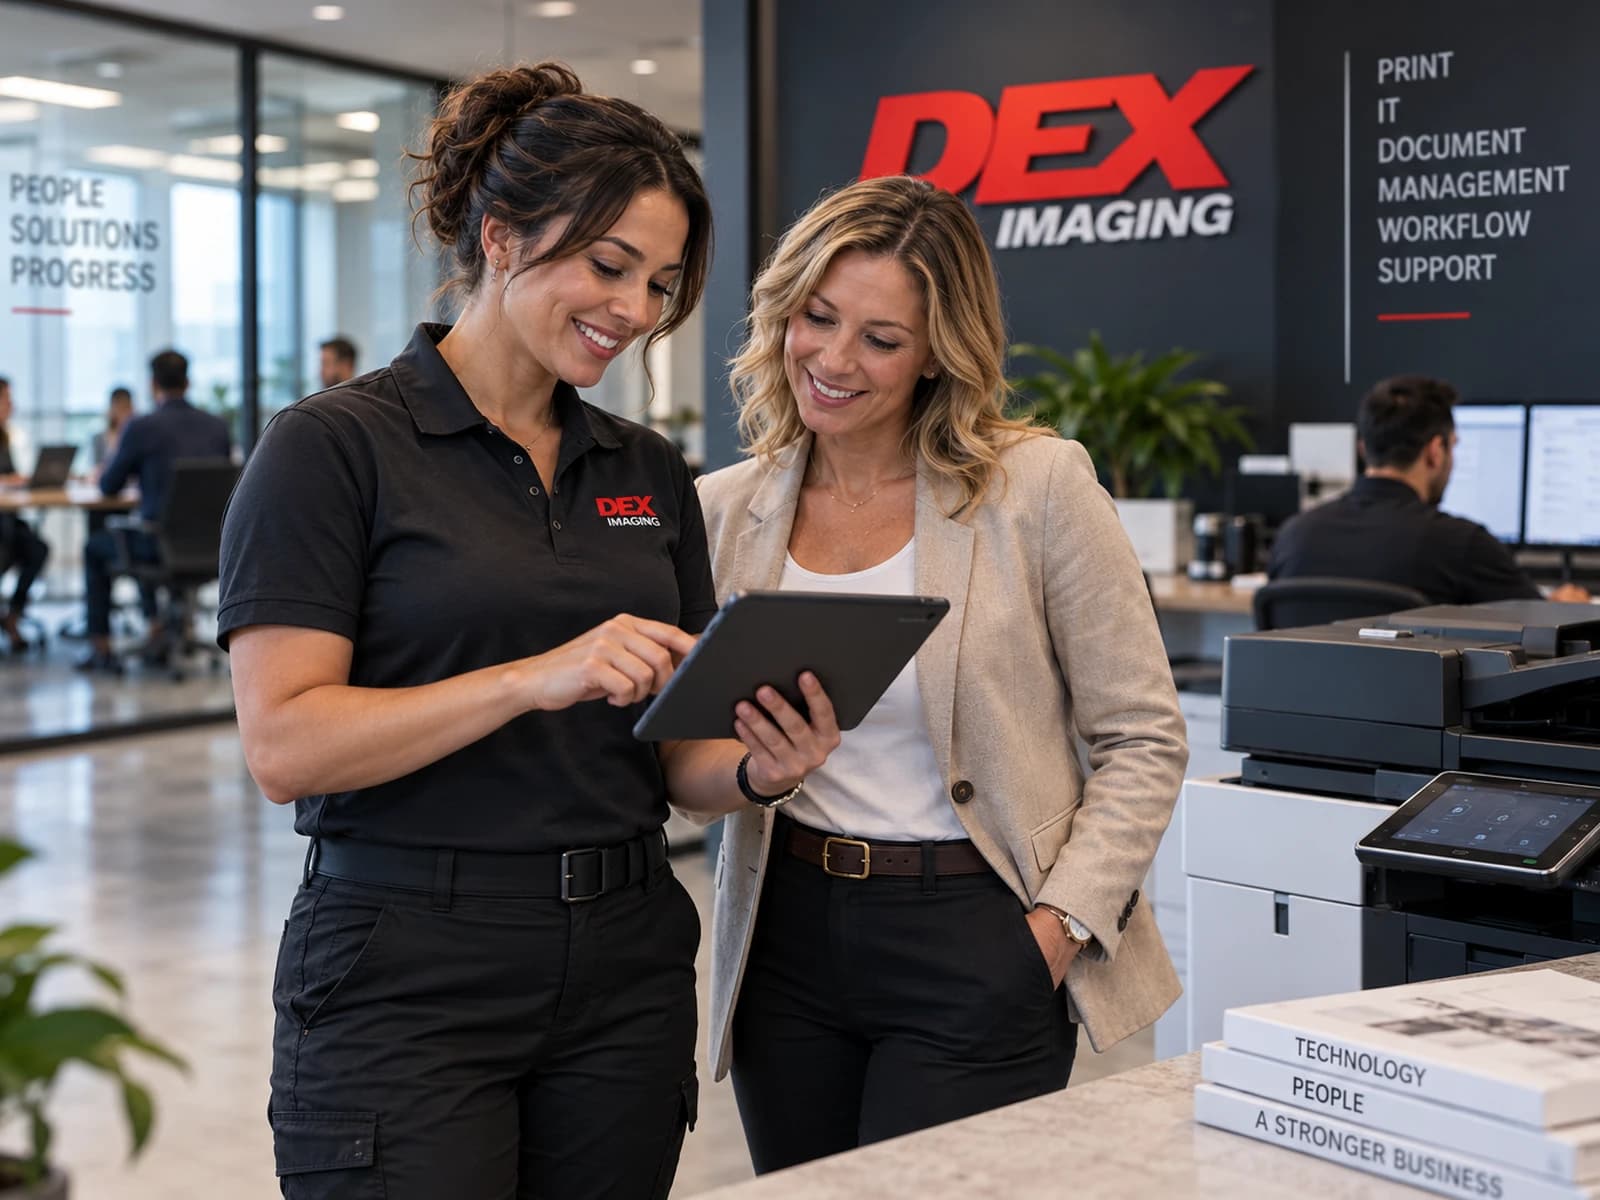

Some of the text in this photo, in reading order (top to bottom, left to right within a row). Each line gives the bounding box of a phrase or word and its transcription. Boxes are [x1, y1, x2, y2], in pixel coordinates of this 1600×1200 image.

[1377, 51, 1453, 84] PRINT
[1377, 97, 1399, 123] IT
[860, 65, 1254, 204] DEX
[1377, 127, 1526, 164] DOCUMENT
[10, 173, 104, 208] PEOPLE
[1377, 165, 1569, 203] MANAGEMENT
[10, 214, 159, 250] SOLUTIONS
[996, 192, 1234, 249] IMAGING
[1377, 210, 1531, 243] WORKFLOW
[11, 256, 156, 293] PROGRESS
[1377, 253, 1497, 284] SUPPORT
[595, 495, 656, 516] DEX
[607, 516, 661, 528] IMAGING
[1295, 1037, 1427, 1087] TECHNOLOGY
[1292, 1076, 1365, 1114] PEOPLE
[1255, 1110, 1503, 1198] A STRONGER BUSINESS
